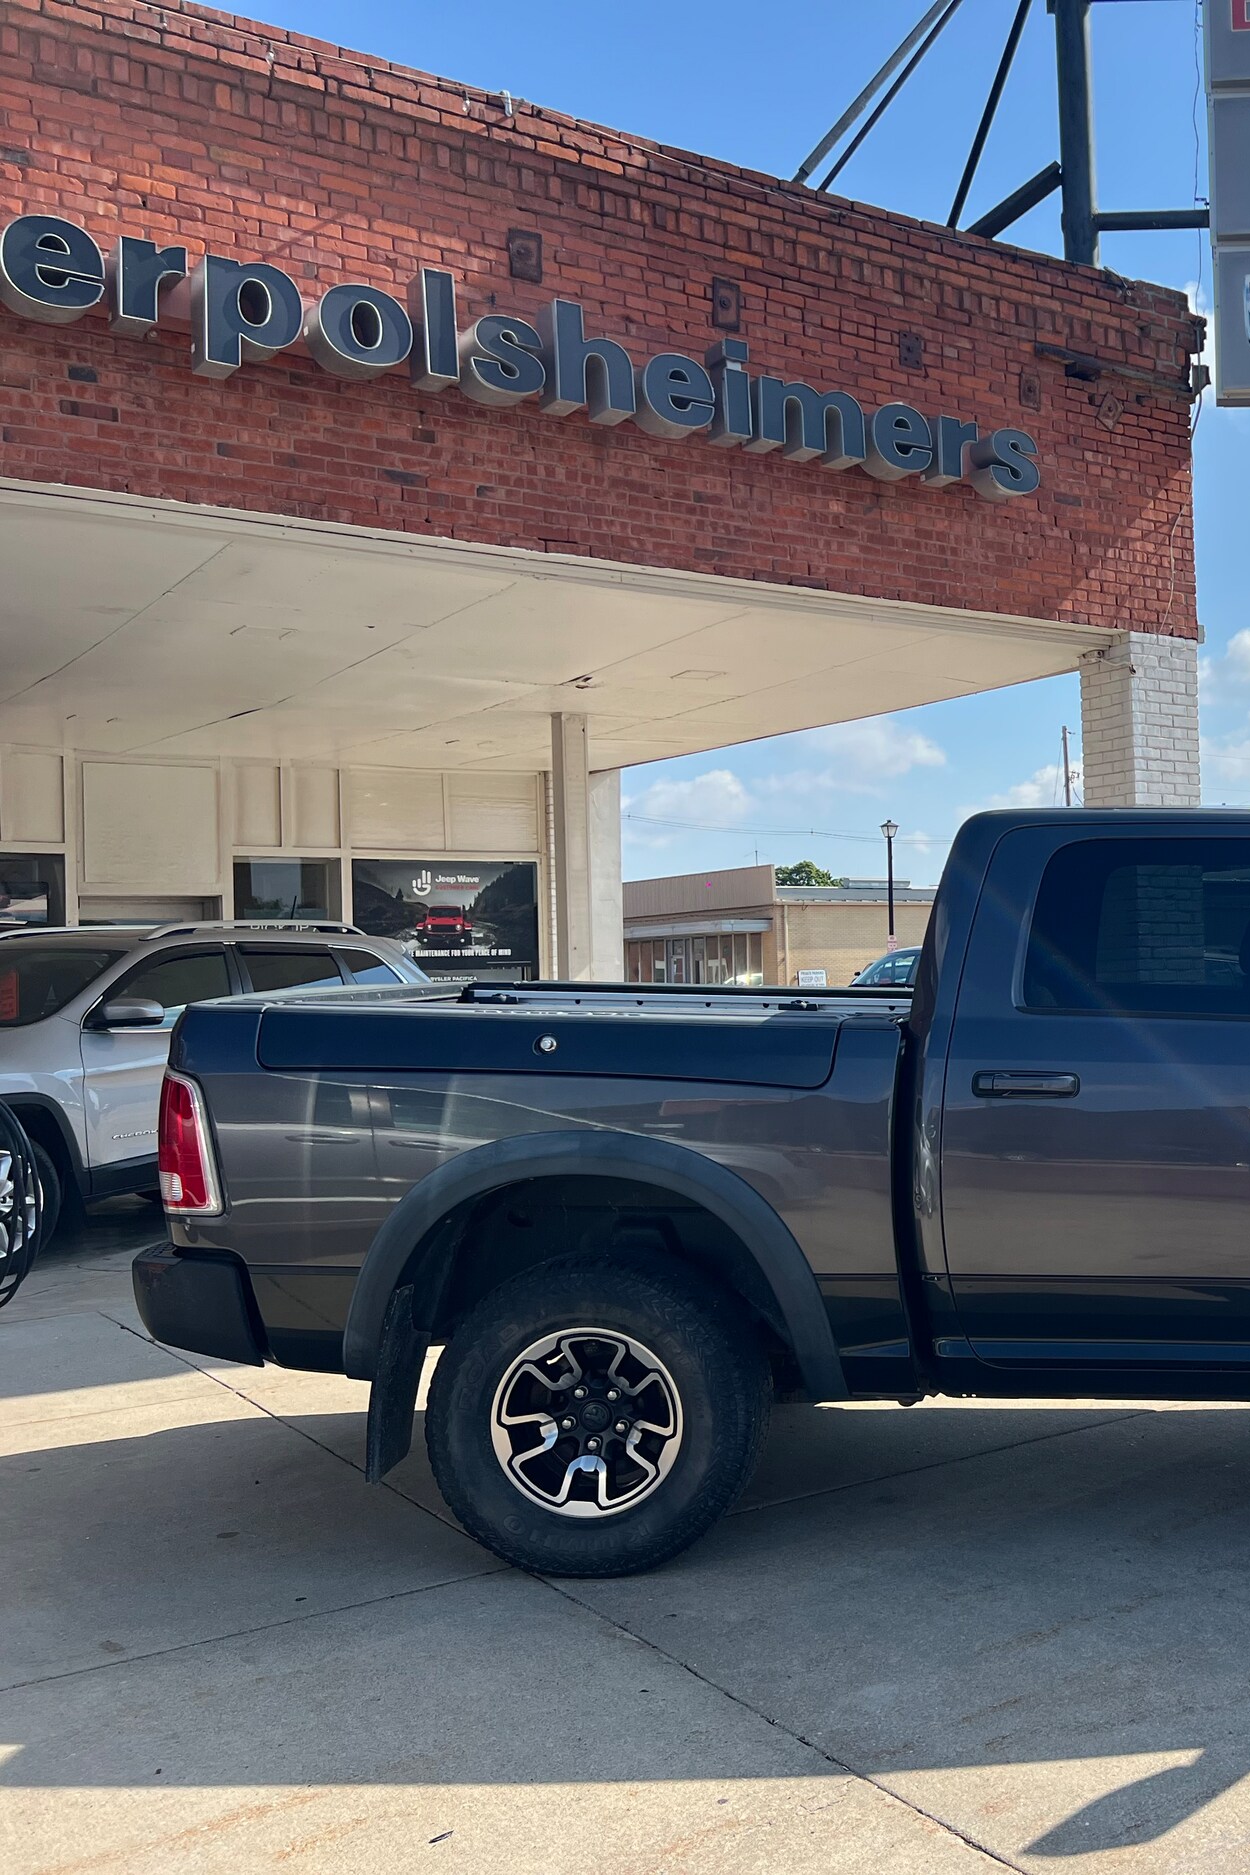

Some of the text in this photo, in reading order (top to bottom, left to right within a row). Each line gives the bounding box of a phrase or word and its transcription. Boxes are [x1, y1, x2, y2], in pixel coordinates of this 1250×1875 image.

[0, 213, 1041, 498] erpolsheimers
[435, 874, 480, 884] Jeep Wave
[415, 949, 450, 957] MAINTENANCE
[451, 949, 461, 957] FOR
[491, 948, 497, 956] OF
[498, 948, 511, 956] MIND
